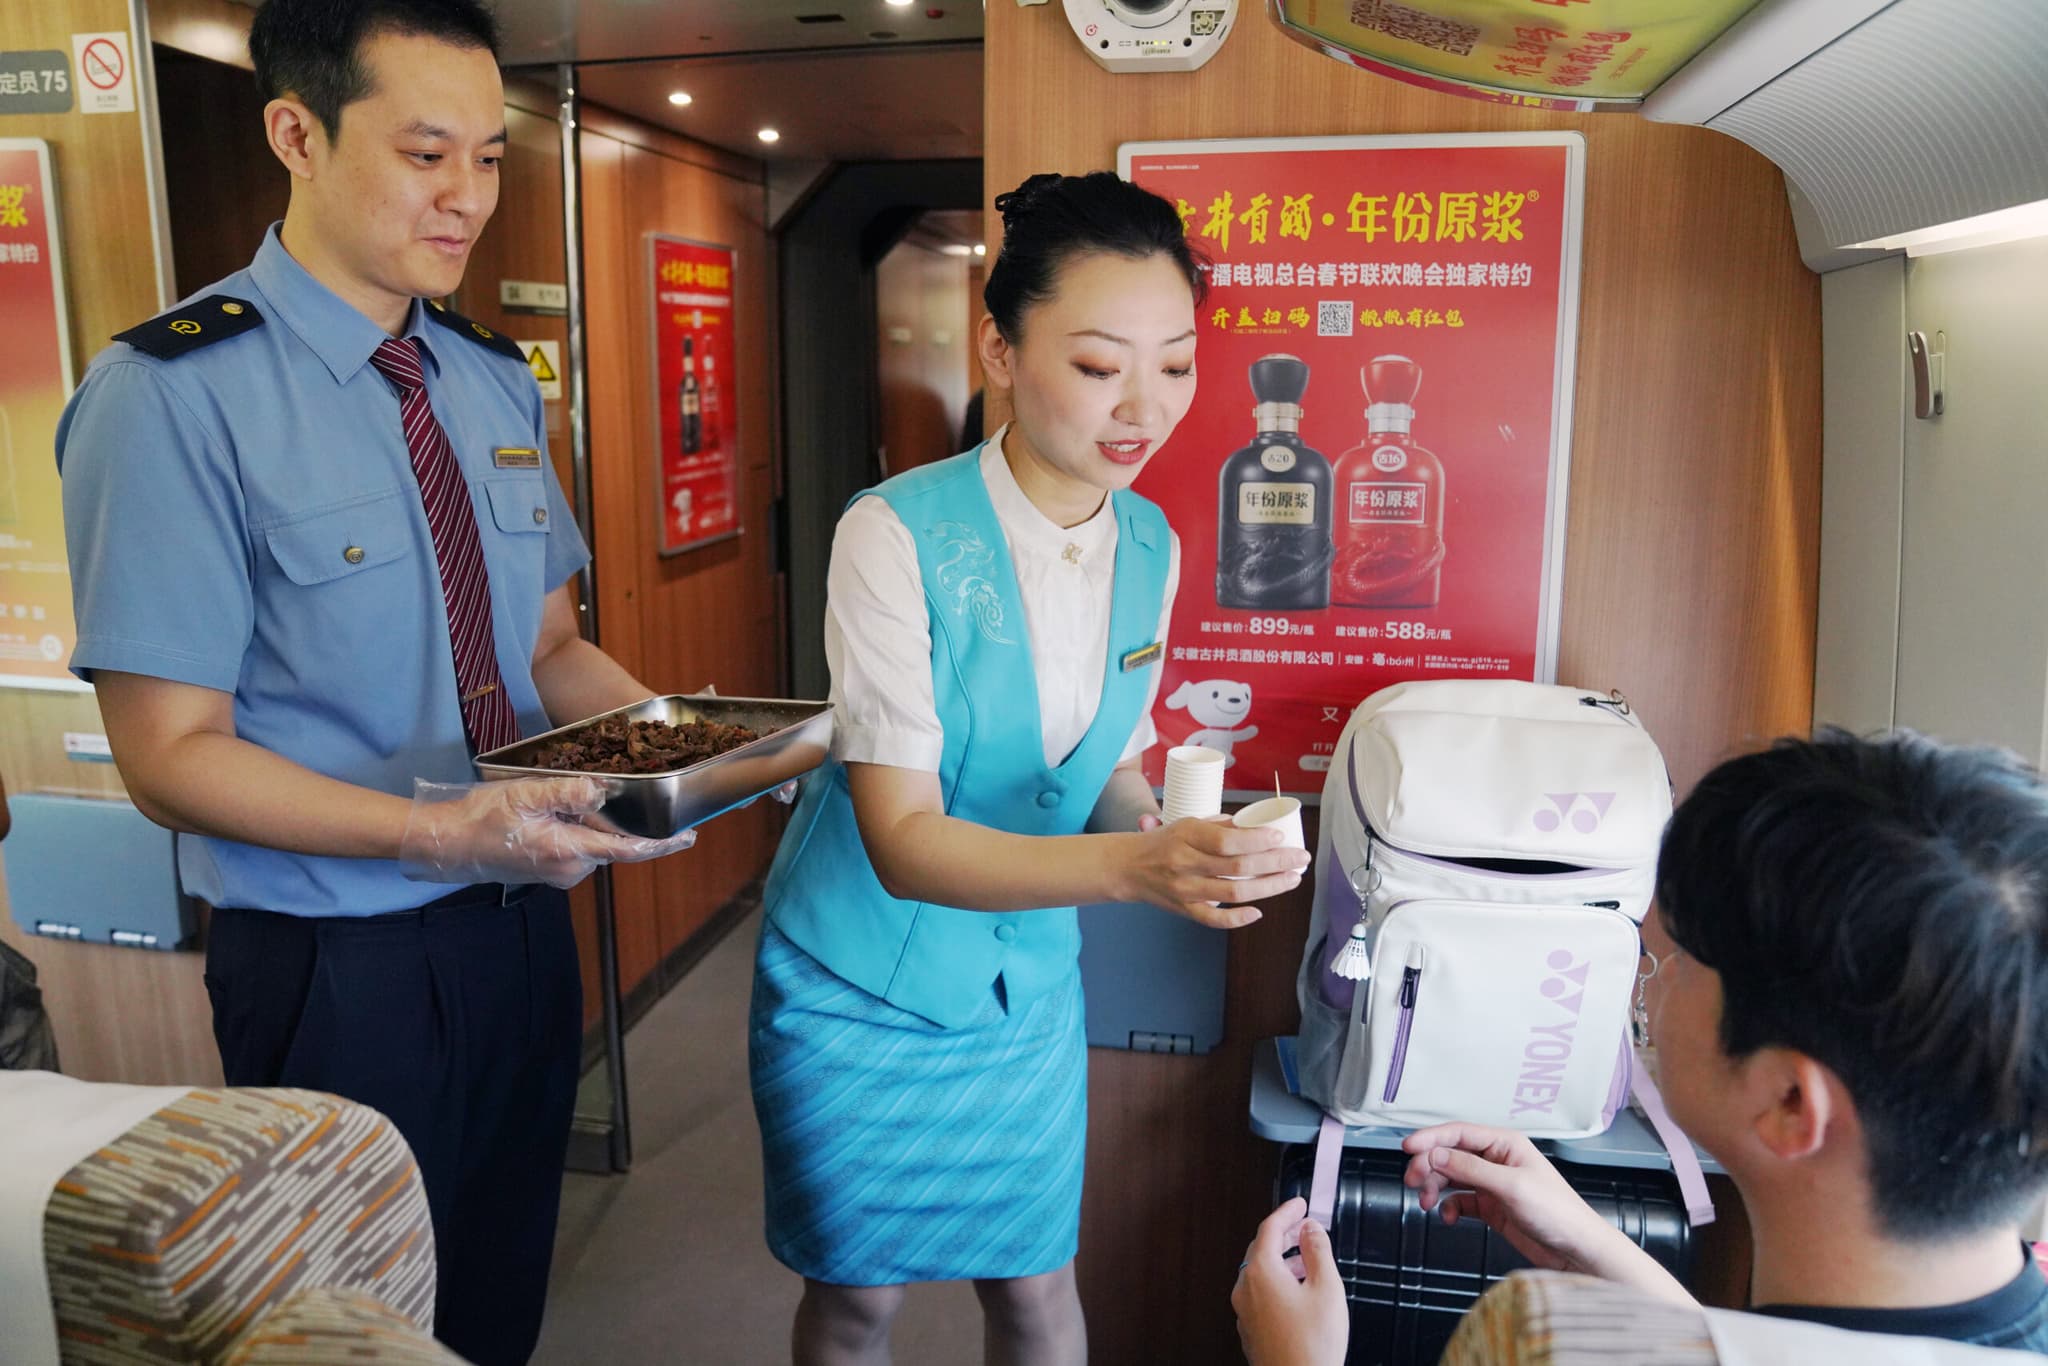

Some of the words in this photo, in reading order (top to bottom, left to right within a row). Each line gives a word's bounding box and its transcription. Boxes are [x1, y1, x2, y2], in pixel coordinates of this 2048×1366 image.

[1211, 306, 1311, 329] 开盖扫码
[1360, 307, 1465, 328] 瓶瓶有红包
[1245, 491, 1309, 509] 年份原浆
[1354, 490, 1419, 509] 年份原浆
[1172, 647, 1334, 666] 安徽古井贡酒股份有限公司
[1509, 1020, 1578, 1115] YONEX
